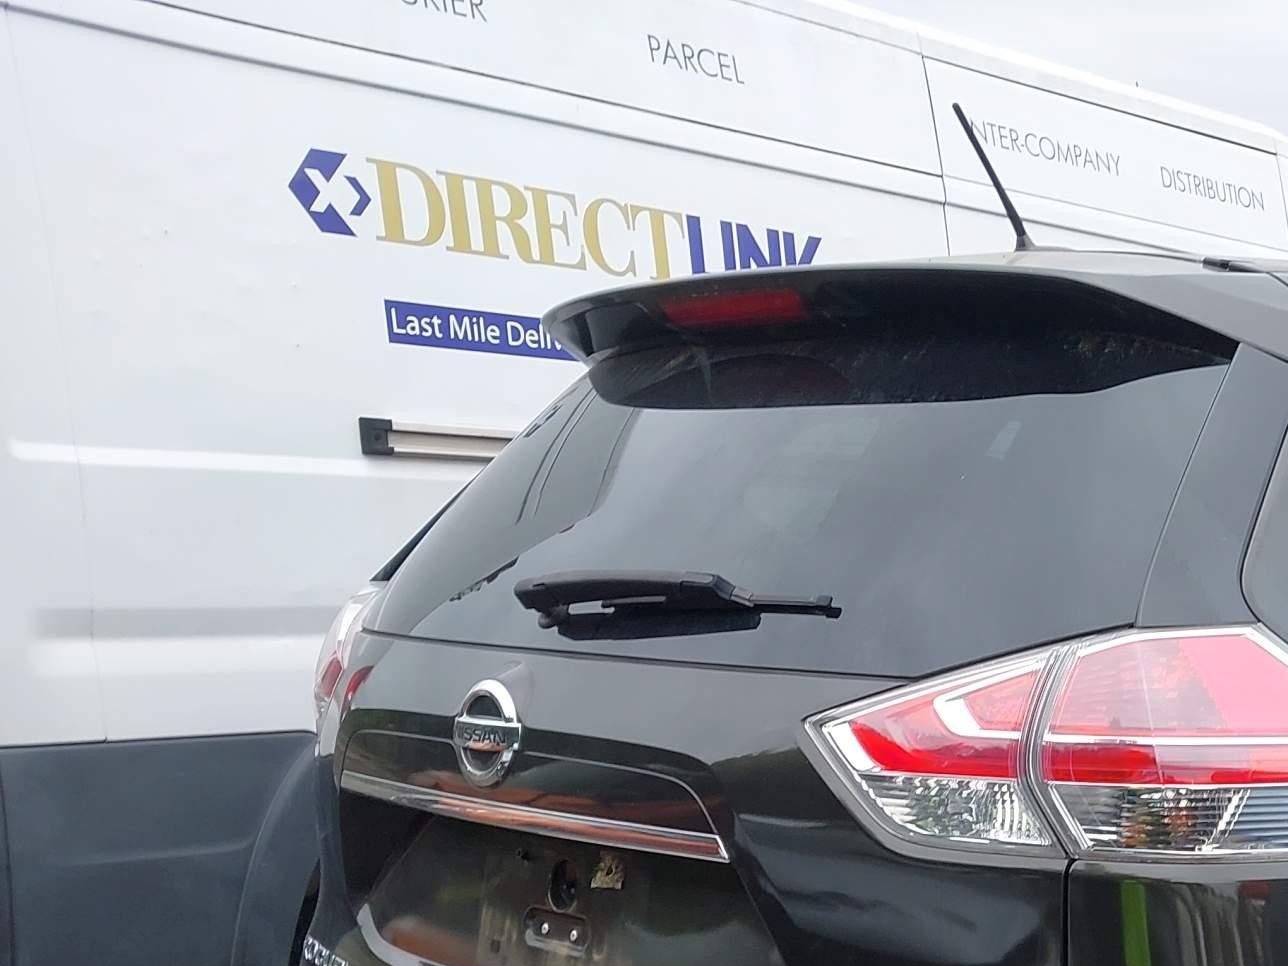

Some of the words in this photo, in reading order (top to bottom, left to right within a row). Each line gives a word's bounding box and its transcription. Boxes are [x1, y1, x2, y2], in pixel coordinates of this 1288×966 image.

[647, 34, 745, 84] PARCEL
[971, 118, 1120, 176] NTER-COMPANY
[1160, 166, 1265, 211] DISTRIBUTION
[391, 307, 442, 338] Last
[449, 314, 500, 344] Mile
